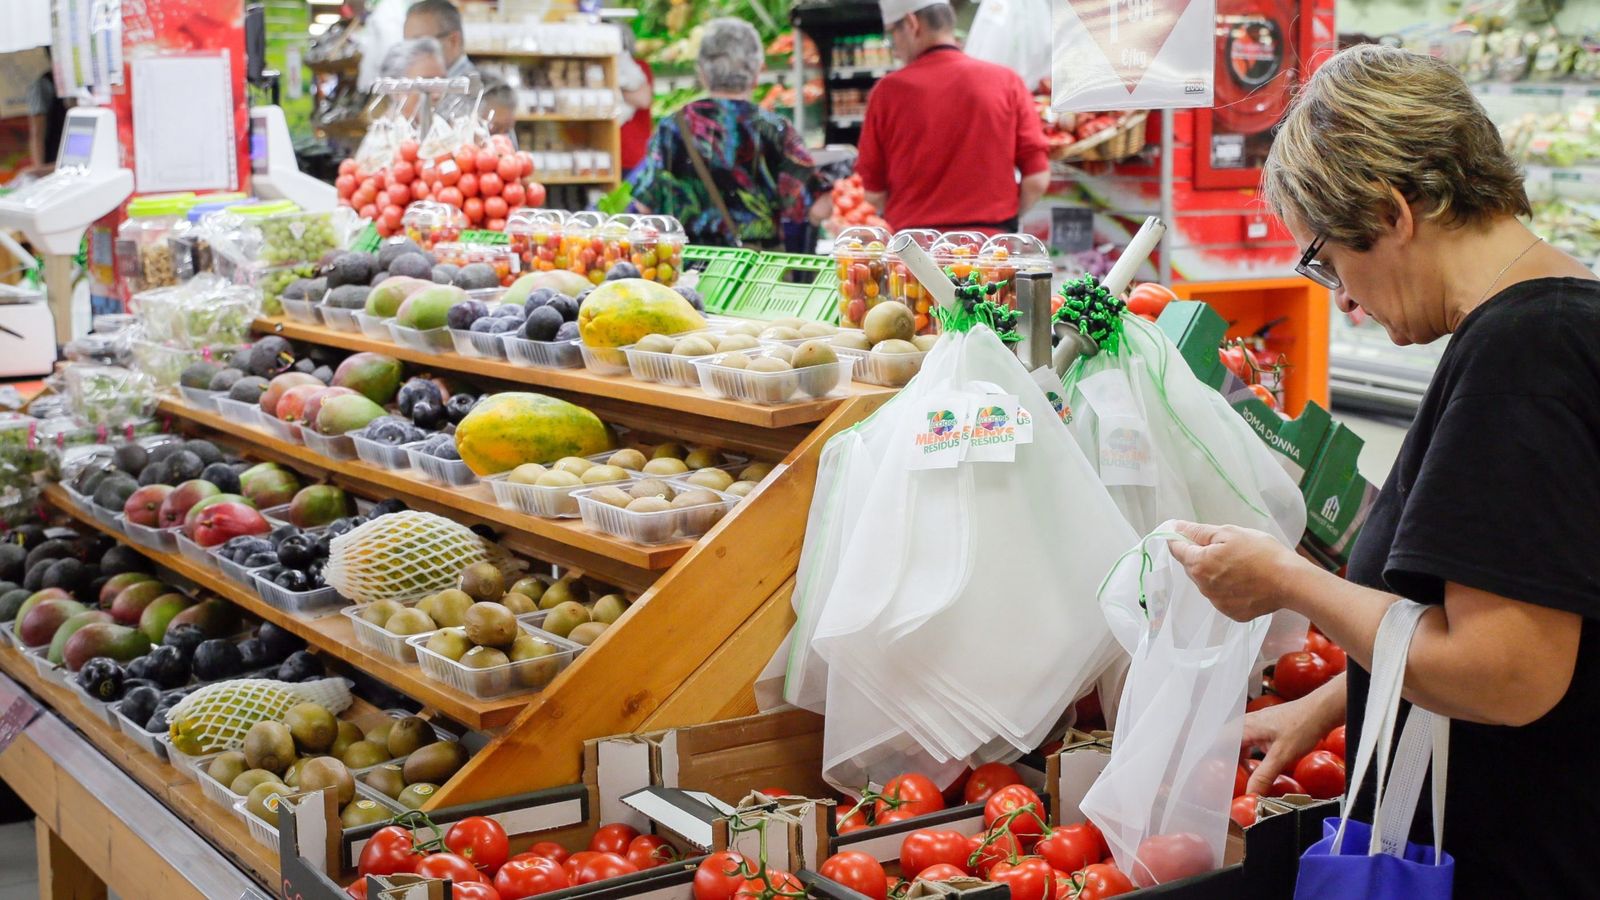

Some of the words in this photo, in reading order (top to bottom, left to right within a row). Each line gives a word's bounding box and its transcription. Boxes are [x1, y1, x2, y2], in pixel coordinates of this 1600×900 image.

[1121, 48, 1148, 71] €/kg
[970, 433, 1014, 446] RESIDUS
[1243, 405, 1265, 436] ROMA
[1264, 428, 1301, 460] DONNA
[923, 438, 960, 454] RESIDUS
